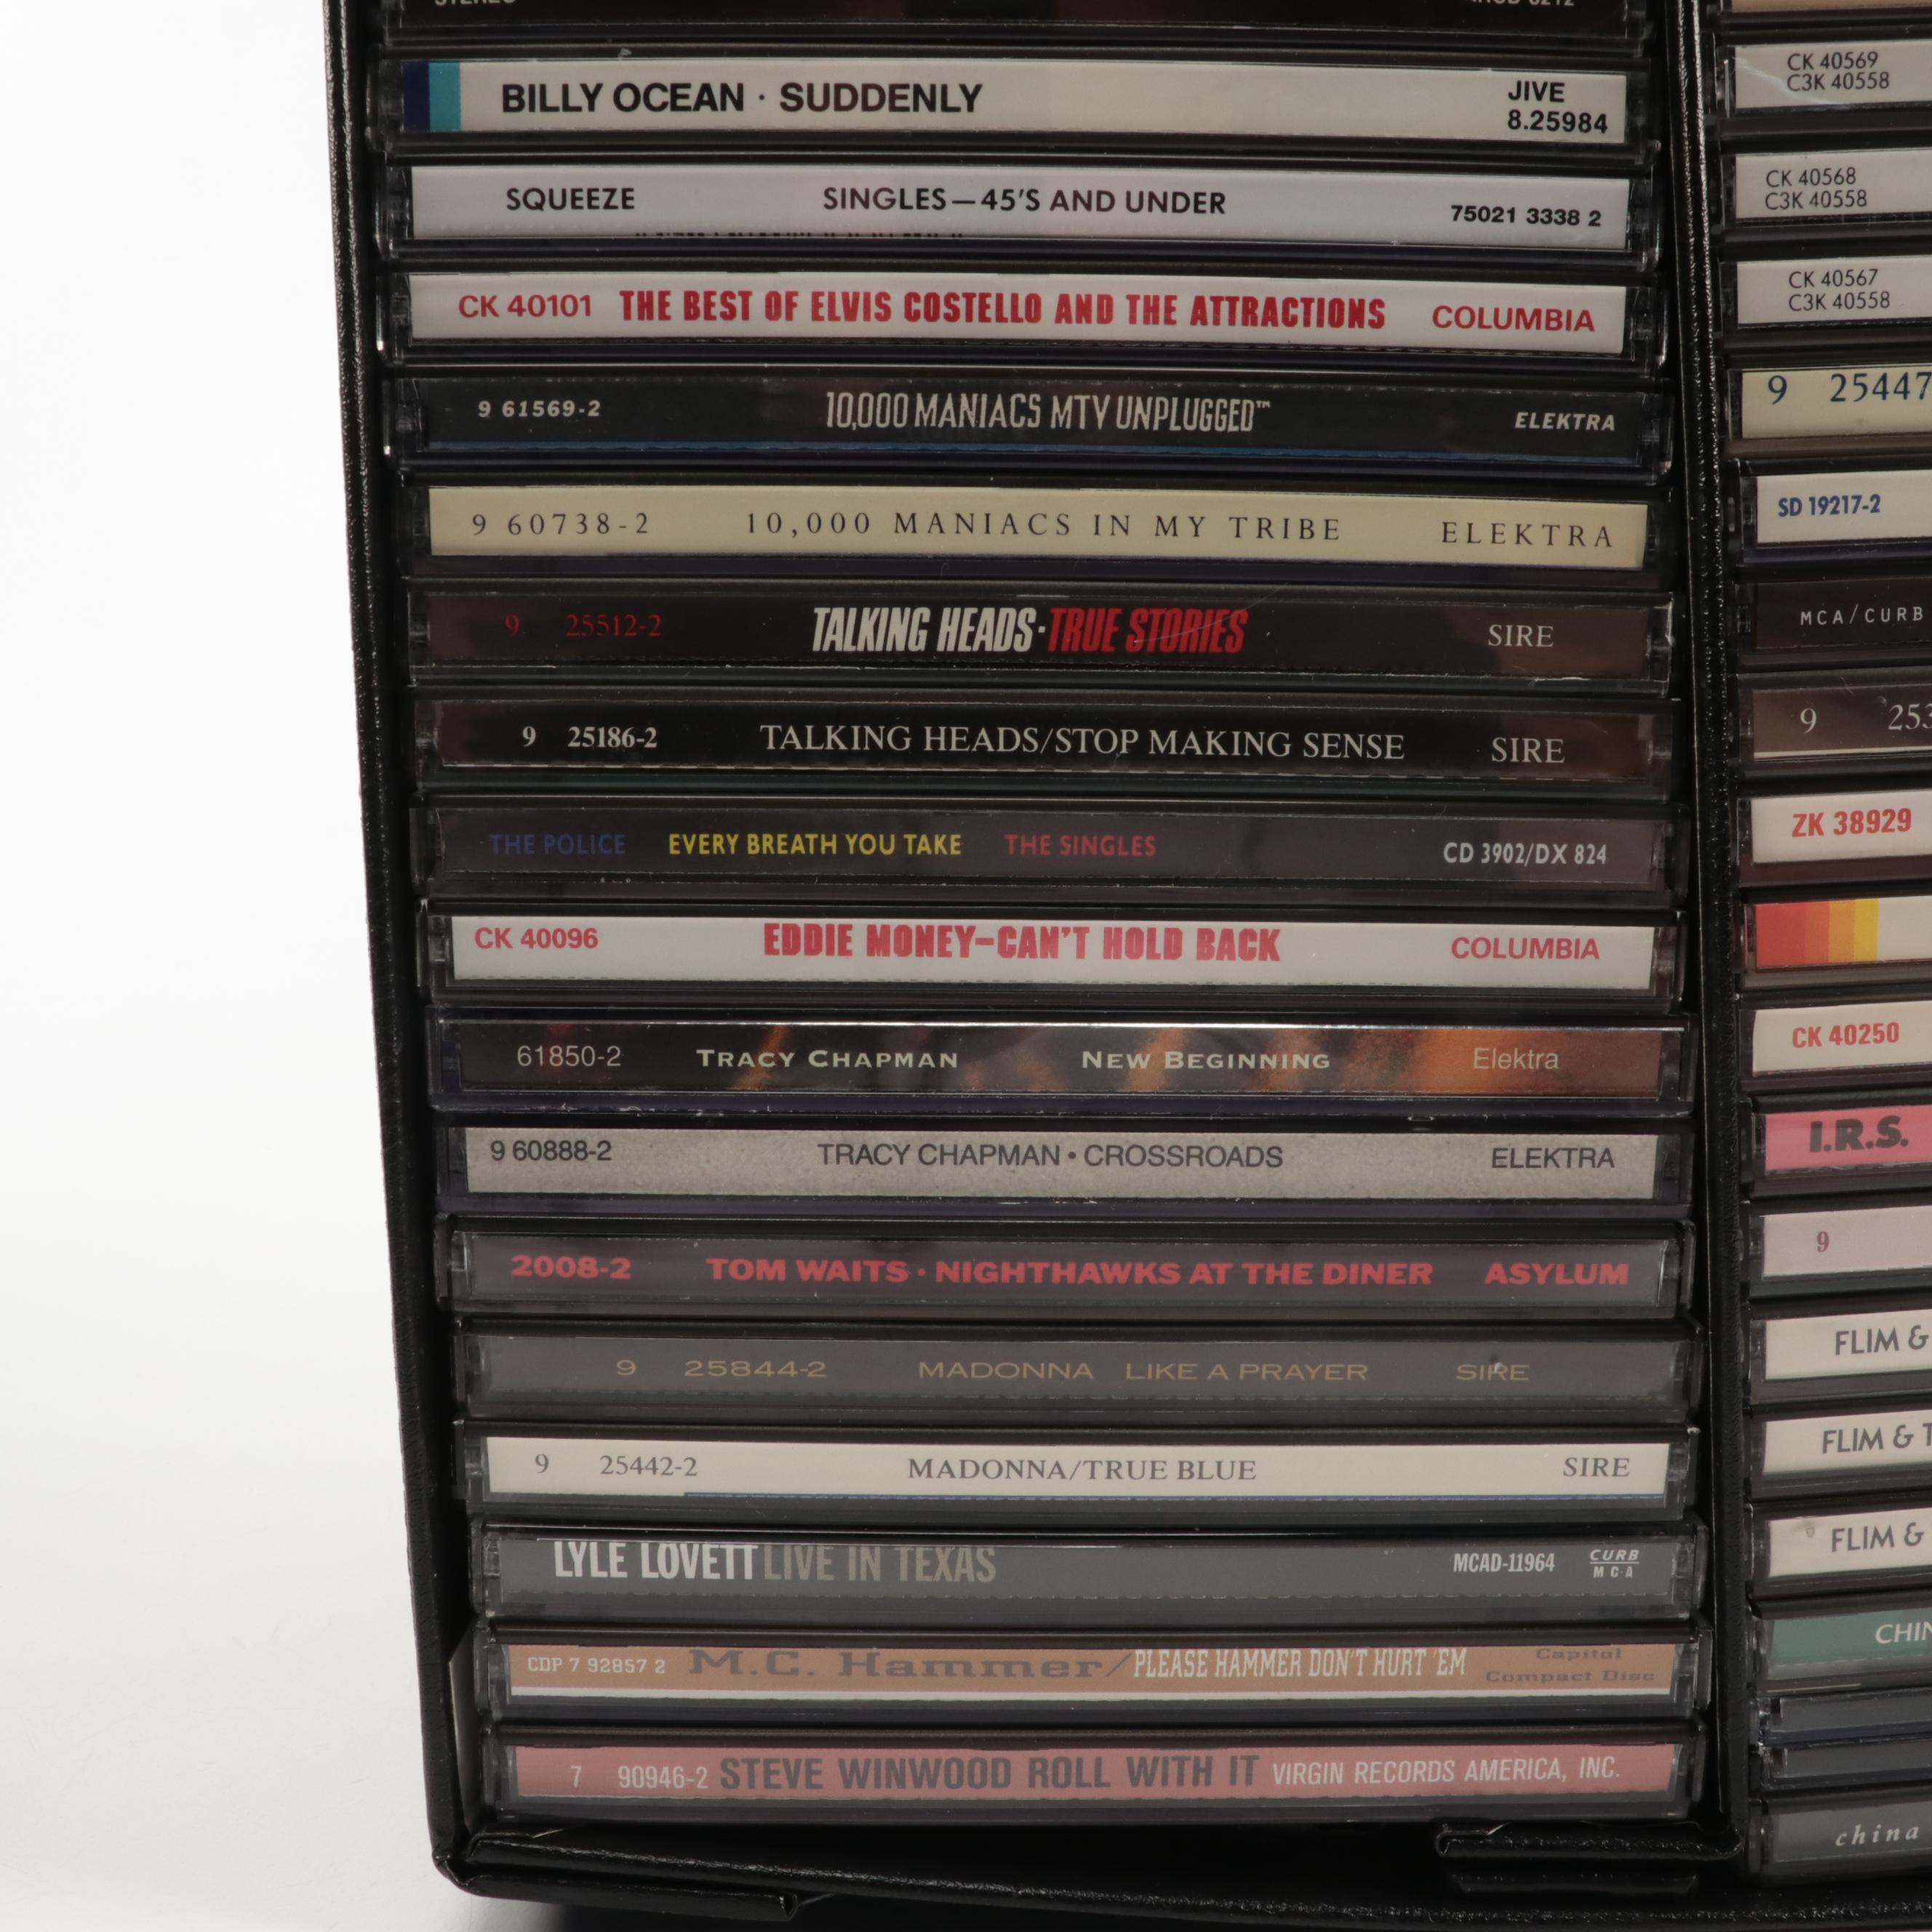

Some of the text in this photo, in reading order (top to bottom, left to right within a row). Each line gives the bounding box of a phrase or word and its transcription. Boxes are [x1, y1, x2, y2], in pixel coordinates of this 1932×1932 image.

[1787, 51, 1878, 71] CK 40569
[1509, 81, 1565, 103] JIVE
[1787, 71, 1889, 91] C3K 40558
[503, 82, 982, 113] BILLY OCEAN SUDDENLY
[1508, 109, 1608, 134] 8.25984
[1766, 167, 1856, 188] CK 40568
[507, 188, 1601, 227] SQUEEZE AND UNDER 75021 3338 2
[1765, 189, 1867, 210] C3K 40558
[1789, 268, 1878, 289] CK 40567
[459, 290, 1594, 332] CK 40101 THE BEST OF ELVIS COSTELLO AND THE ATTRACTIONS COLUMBIA
[1789, 291, 1890, 311] C3K 40558
[1768, 375, 1787, 404] 9
[479, 392, 1614, 431] 9 61569-2 10,000 MANIACS MTV ELEKTRA
[1779, 494, 1880, 517] SD 19217-2
[473, 513, 1612, 547] 9 60738-2 10,000 MANIACS IN MY TRIBE ELEKTRA
[1801, 604, 1923, 625] MCA/CURB
[505, 607, 1553, 652] 9 25512-2 TALKING STORIES SIRE
[1800, 708, 1816, 733] 9
[522, 726, 536, 746] 9
[568, 727, 657, 748] 25186-2
[760, 725, 911, 751] TALKING
[1149, 730, 1291, 757] MAKING
[1304, 733, 1405, 759] SENSE
[1492, 738, 1565, 763] SIRE
[1792, 808, 1912, 837] ZK 38929
[489, 834, 1606, 866] THE EVERY BREATH YOU TAKE THE SINGLES CD 3902/DX 824
[475, 923, 1600, 961] CK 40096 EDDIE HOLD BACK COLUMBIA
[1792, 1022, 1899, 1048] CK 40250
[517, 1045, 1558, 1071] 61850-2 TRACY CHAPMAN NEW BEGINNING Elektra
[1810, 1115, 1908, 1152] I.R.S.
[490, 1140, 1614, 1168] 9 60888-2 TRACY CHAPMAN CROSSROADS ELEKTRA
[1817, 1232, 1829, 1253] 9
[511, 1255, 1629, 1285] 2008-2 TOM WAITS NIGHTHAWKS AT THE DINER ASYLUM
[1835, 1325, 1929, 1355] FLIM &
[617, 1360, 1529, 1381] 9 25844-2 MADONNA LIKE A PRAYER SIRE
[1823, 1427, 1883, 1453] FLIM
[535, 1454, 1629, 1480] 9 25442-2 MADONNA/TRUE BLUE SIRE
[1832, 1525, 1894, 1552] FLIM
[554, 1541, 1555, 1583] LYLE LOVETT LIVE IN TEXAS MCAD-11964
[1590, 1549, 1639, 1561] CURB
[528, 1648, 1427, 1677] CDP 92857 M.C. HAMMER DON'T HURT
[1536, 1648, 1621, 1661] Capitol
[1486, 1670, 1654, 1685] Compact Disc
[618, 1755, 1619, 1789] 90946-2 STEVE WINWOOD ROLL WITH IT VIRGIN RECORDS AMERICA, INC.
[1836, 1824, 1919, 1845] china
